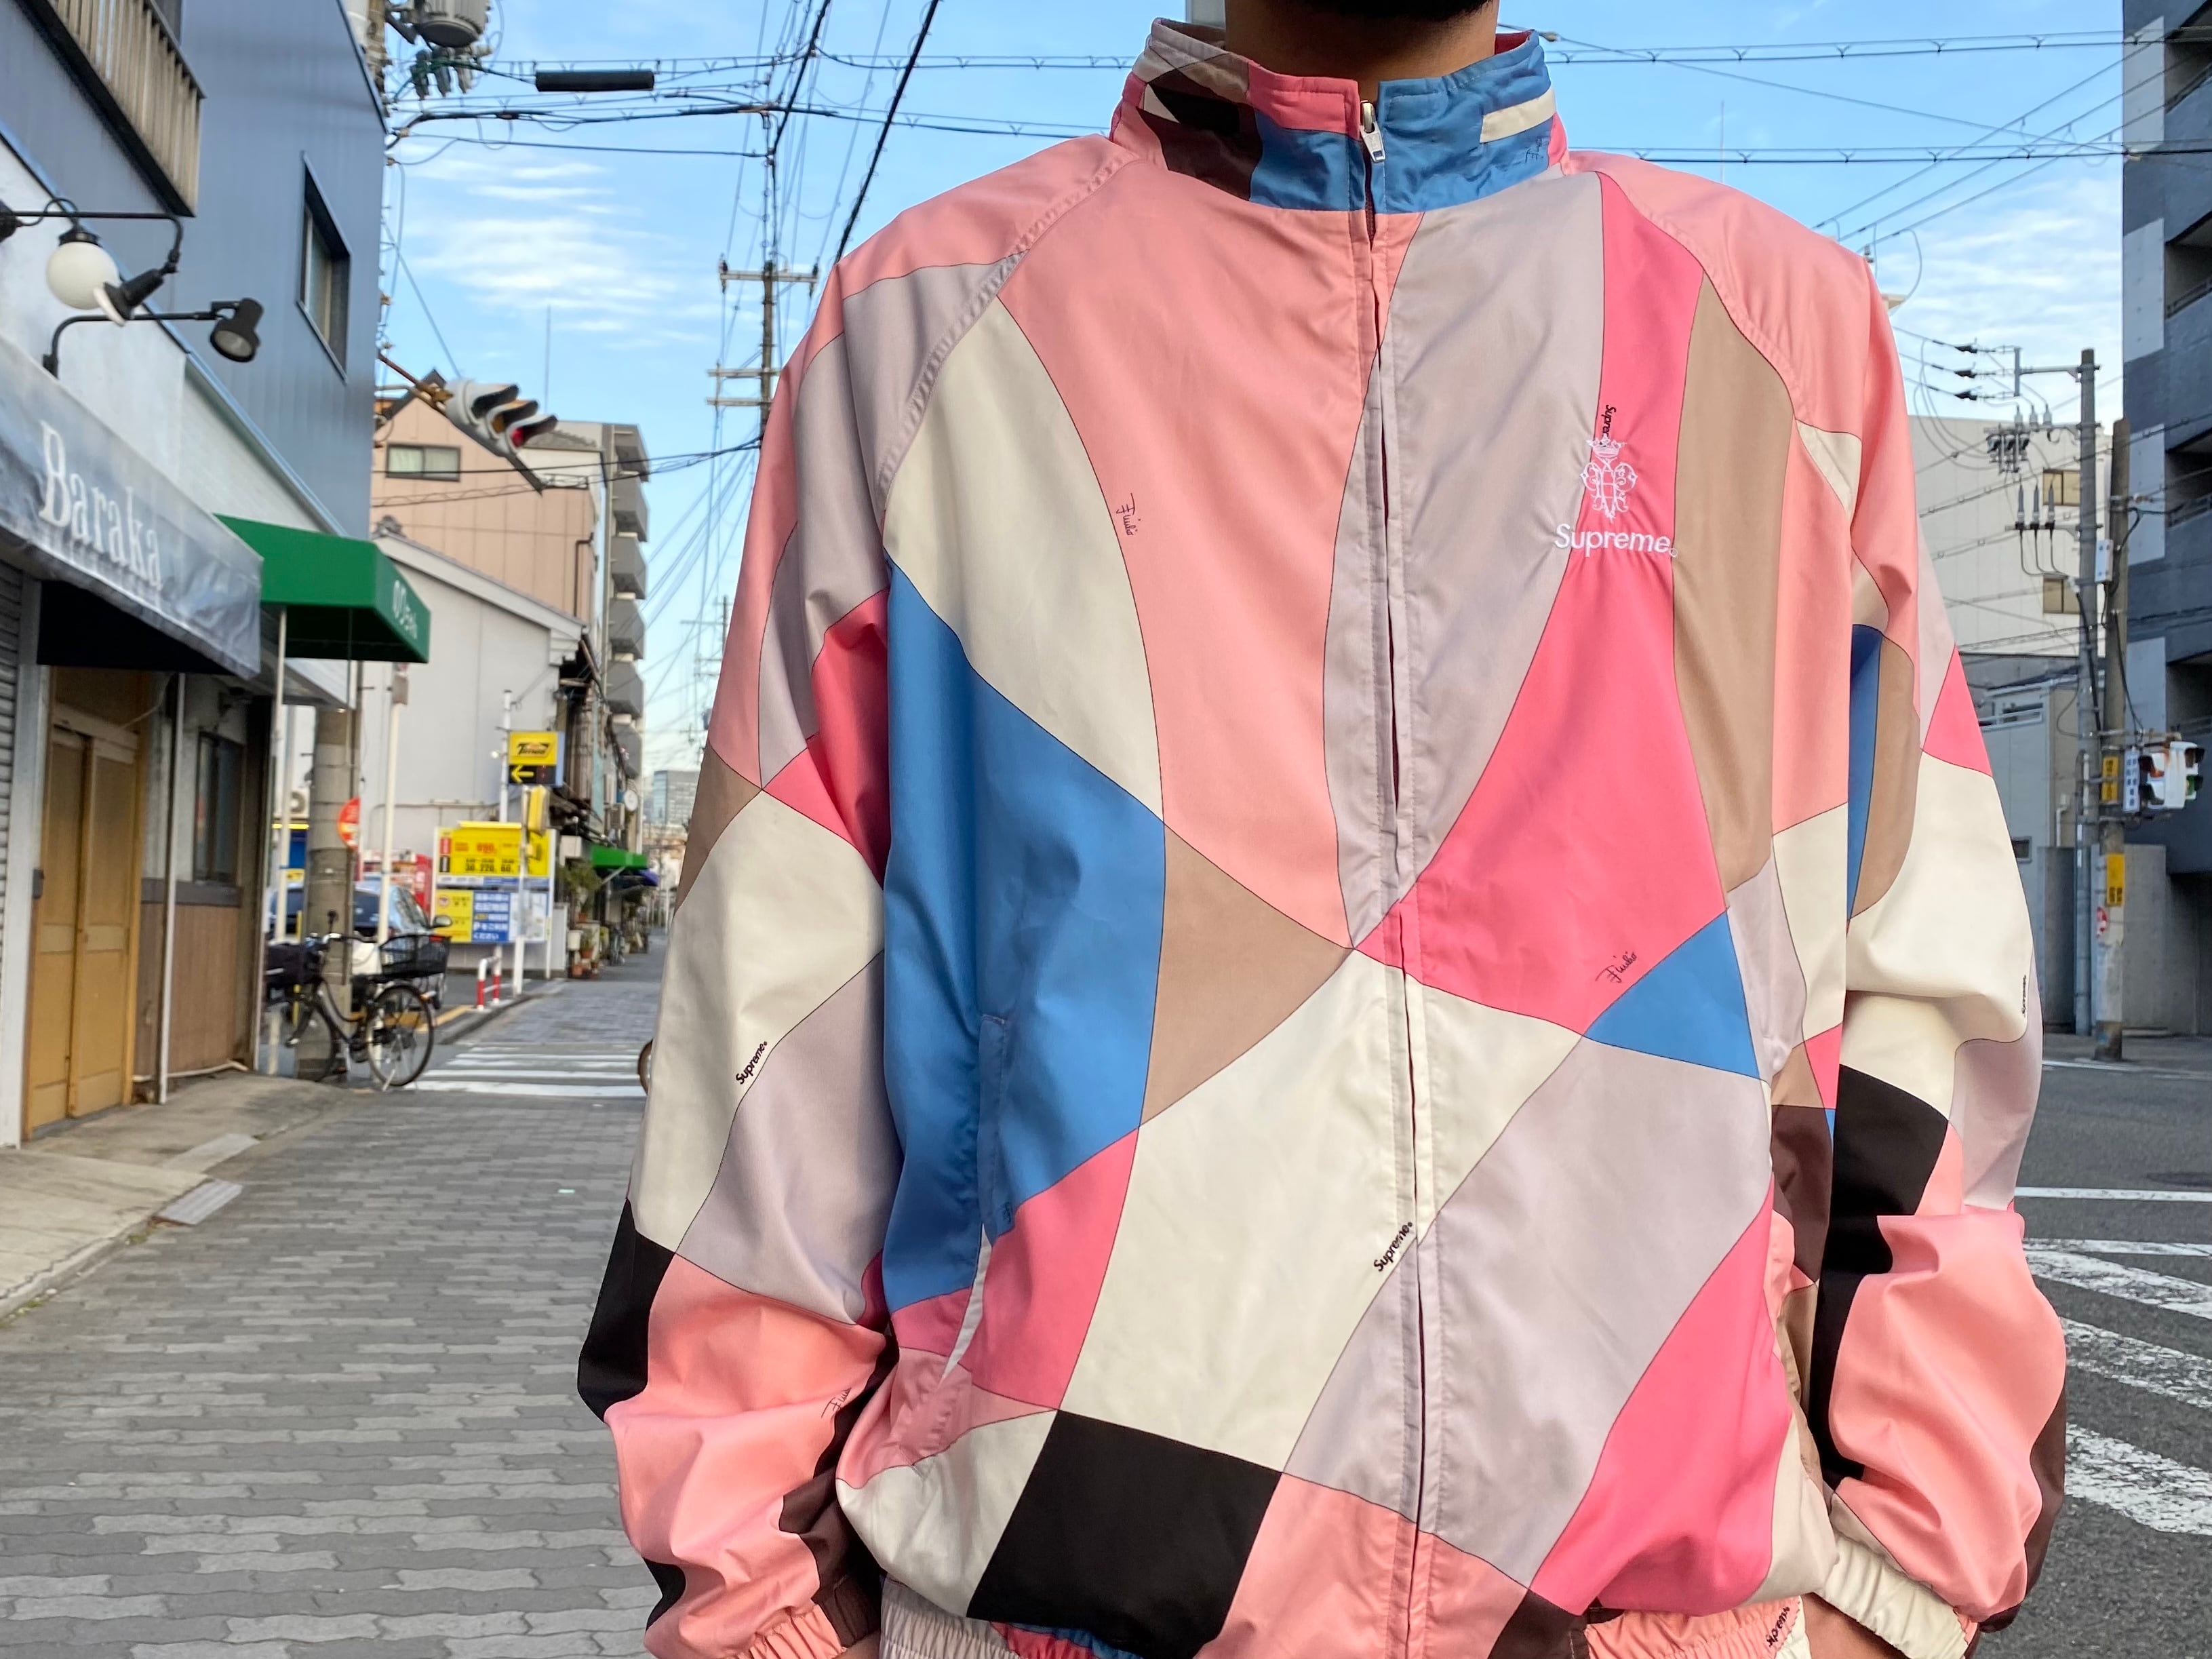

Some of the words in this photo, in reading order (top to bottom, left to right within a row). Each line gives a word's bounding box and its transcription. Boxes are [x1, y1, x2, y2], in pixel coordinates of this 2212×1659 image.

[38, 419, 161, 591] Baraka
[1554, 523, 1671, 558] Supreme
[735, 1042, 766, 1085] Supreme
